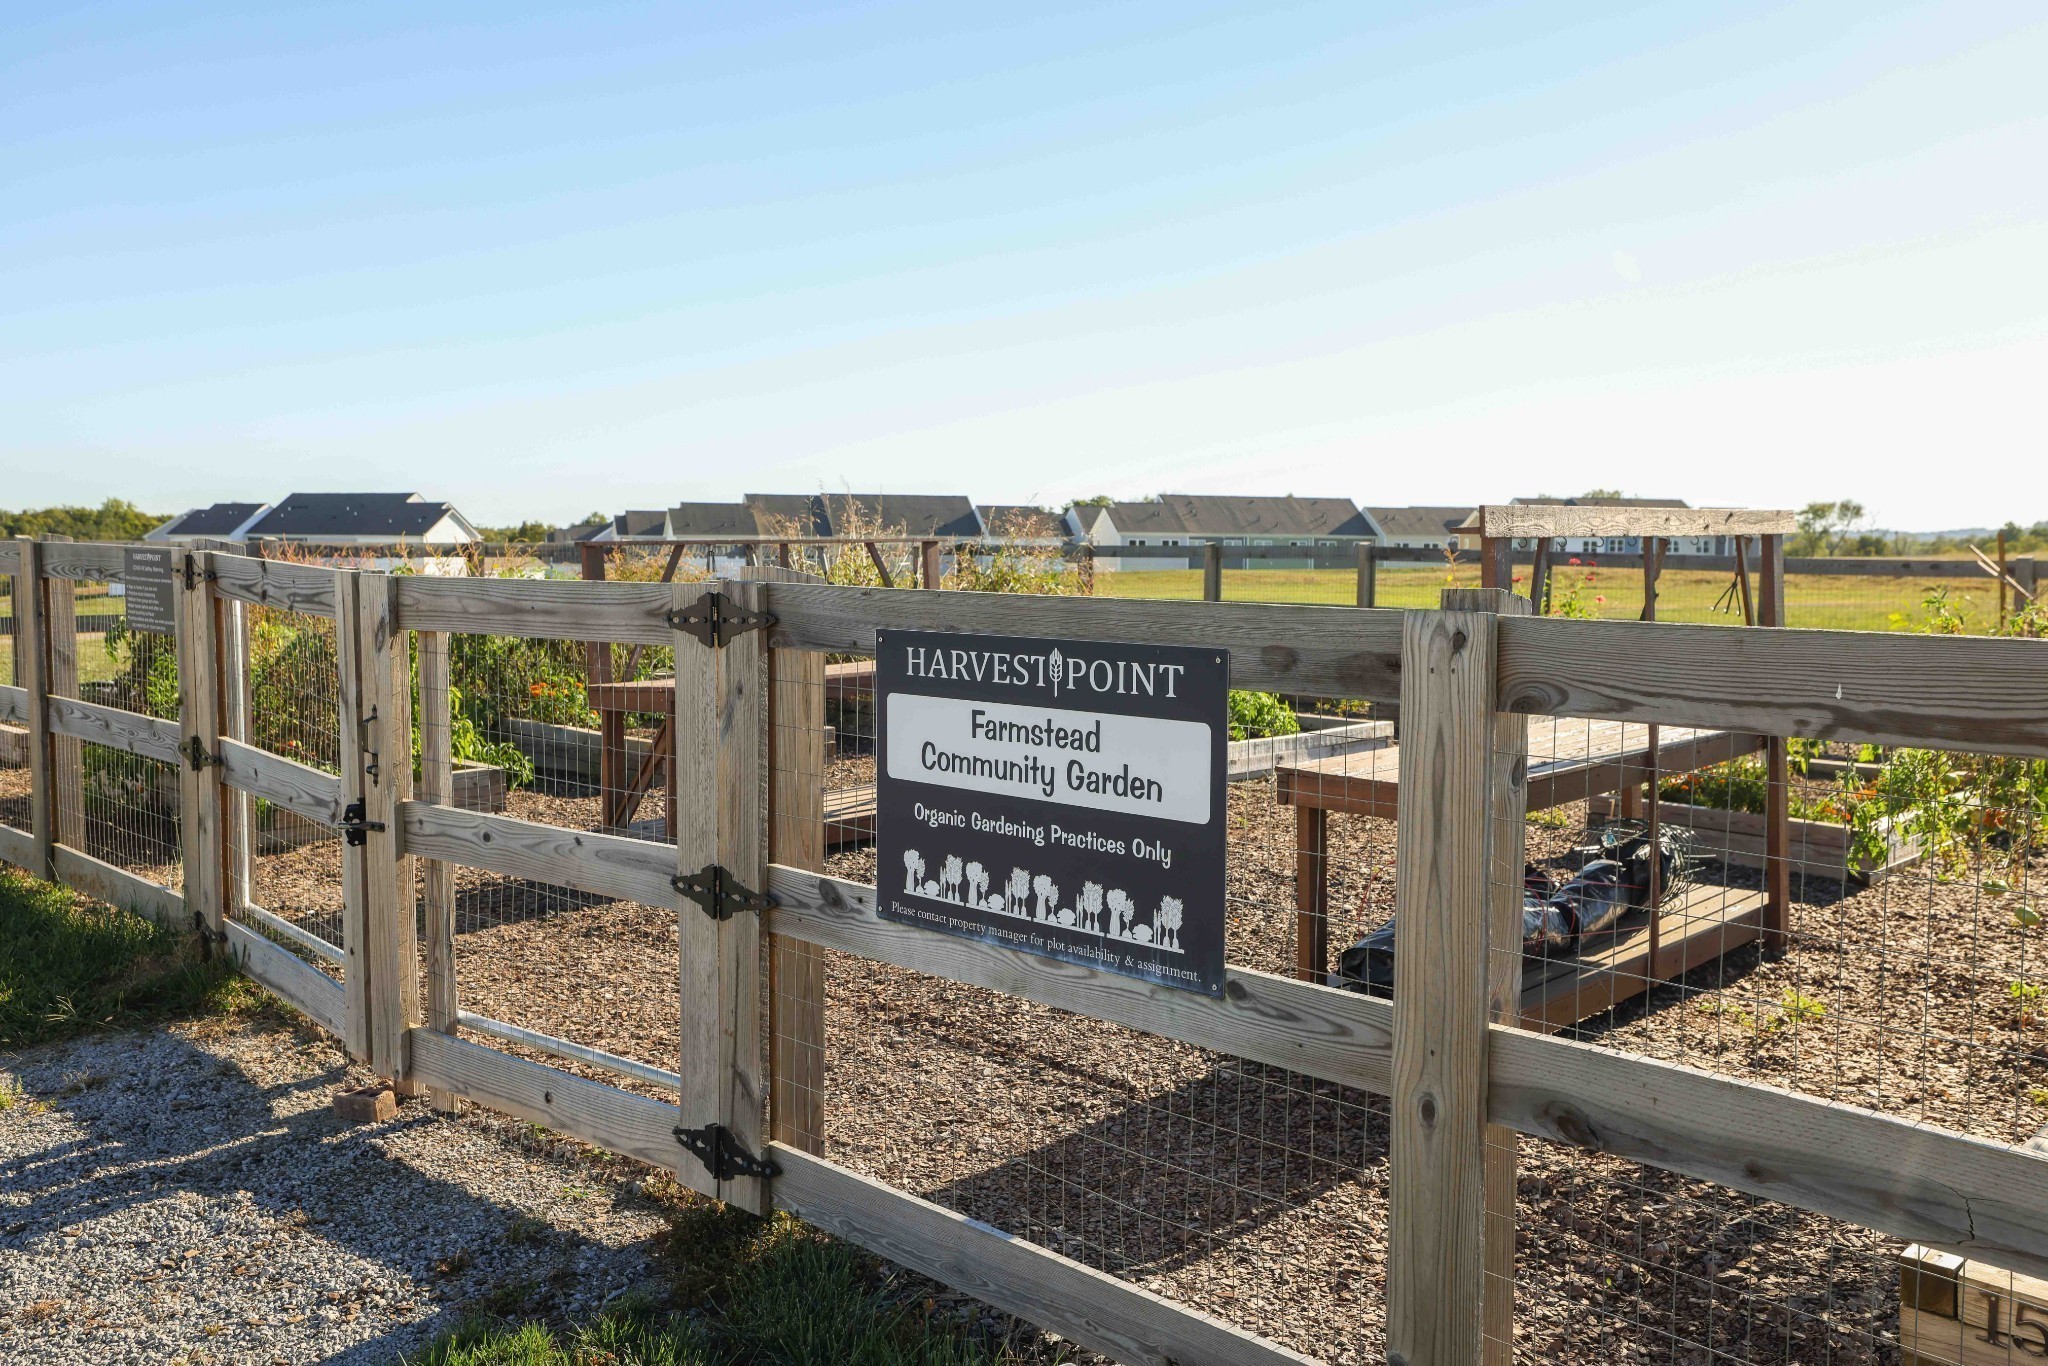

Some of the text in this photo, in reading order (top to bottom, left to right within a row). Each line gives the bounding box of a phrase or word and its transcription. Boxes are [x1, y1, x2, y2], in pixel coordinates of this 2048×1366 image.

[906, 646, 1185, 699] HARVEST POINT
[971, 709, 1101, 753] Farmstead
[921, 740, 1163, 803] Community Garden
[914, 803, 1172, 869] Organic Gardening Practices Only
[891, 901, 1201, 983] Please contact property manager for plot availability & assignment.
[1975, 1290, 2048, 1357] 15
